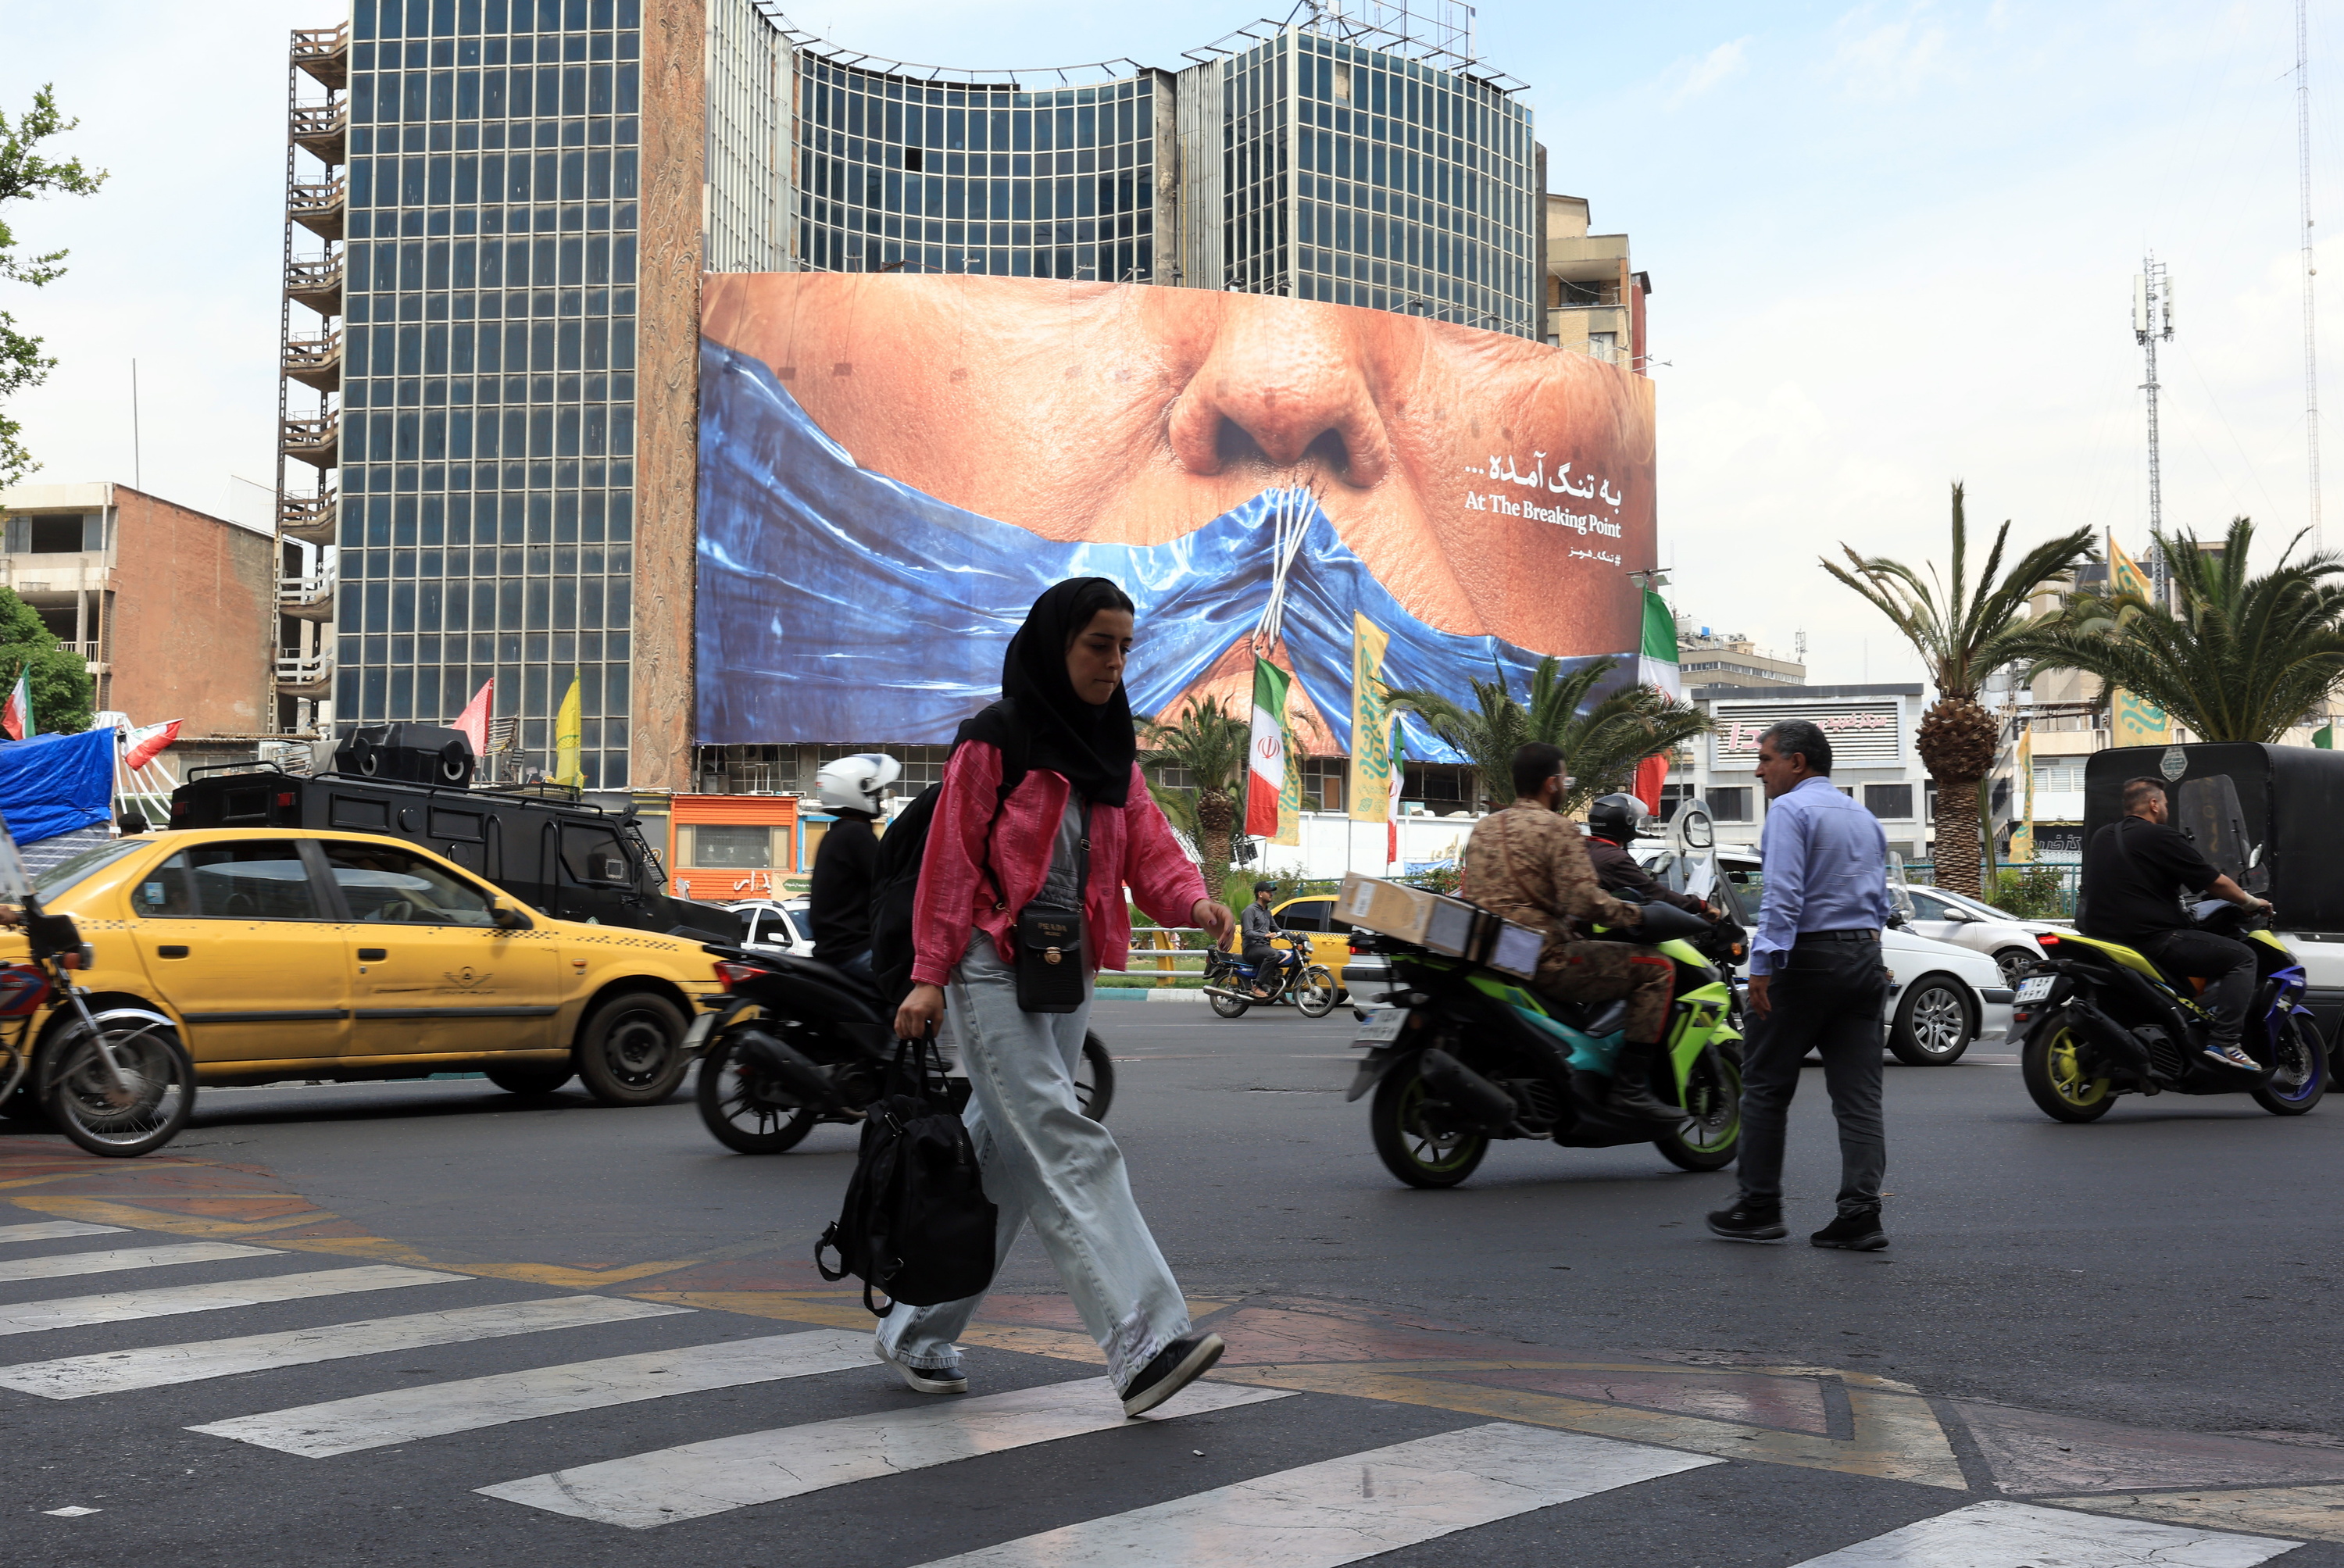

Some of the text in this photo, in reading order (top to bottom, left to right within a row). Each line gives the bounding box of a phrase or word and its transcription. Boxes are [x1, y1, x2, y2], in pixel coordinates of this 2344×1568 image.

[1488, 450, 1547, 488] آمده
[1548, 462, 1595, 499] تنگ
[1464, 491, 1621, 538] At The Breaking Point
[1599, 478, 1622, 515] به
[1827, 713, 1888, 732] مرکز خرید
